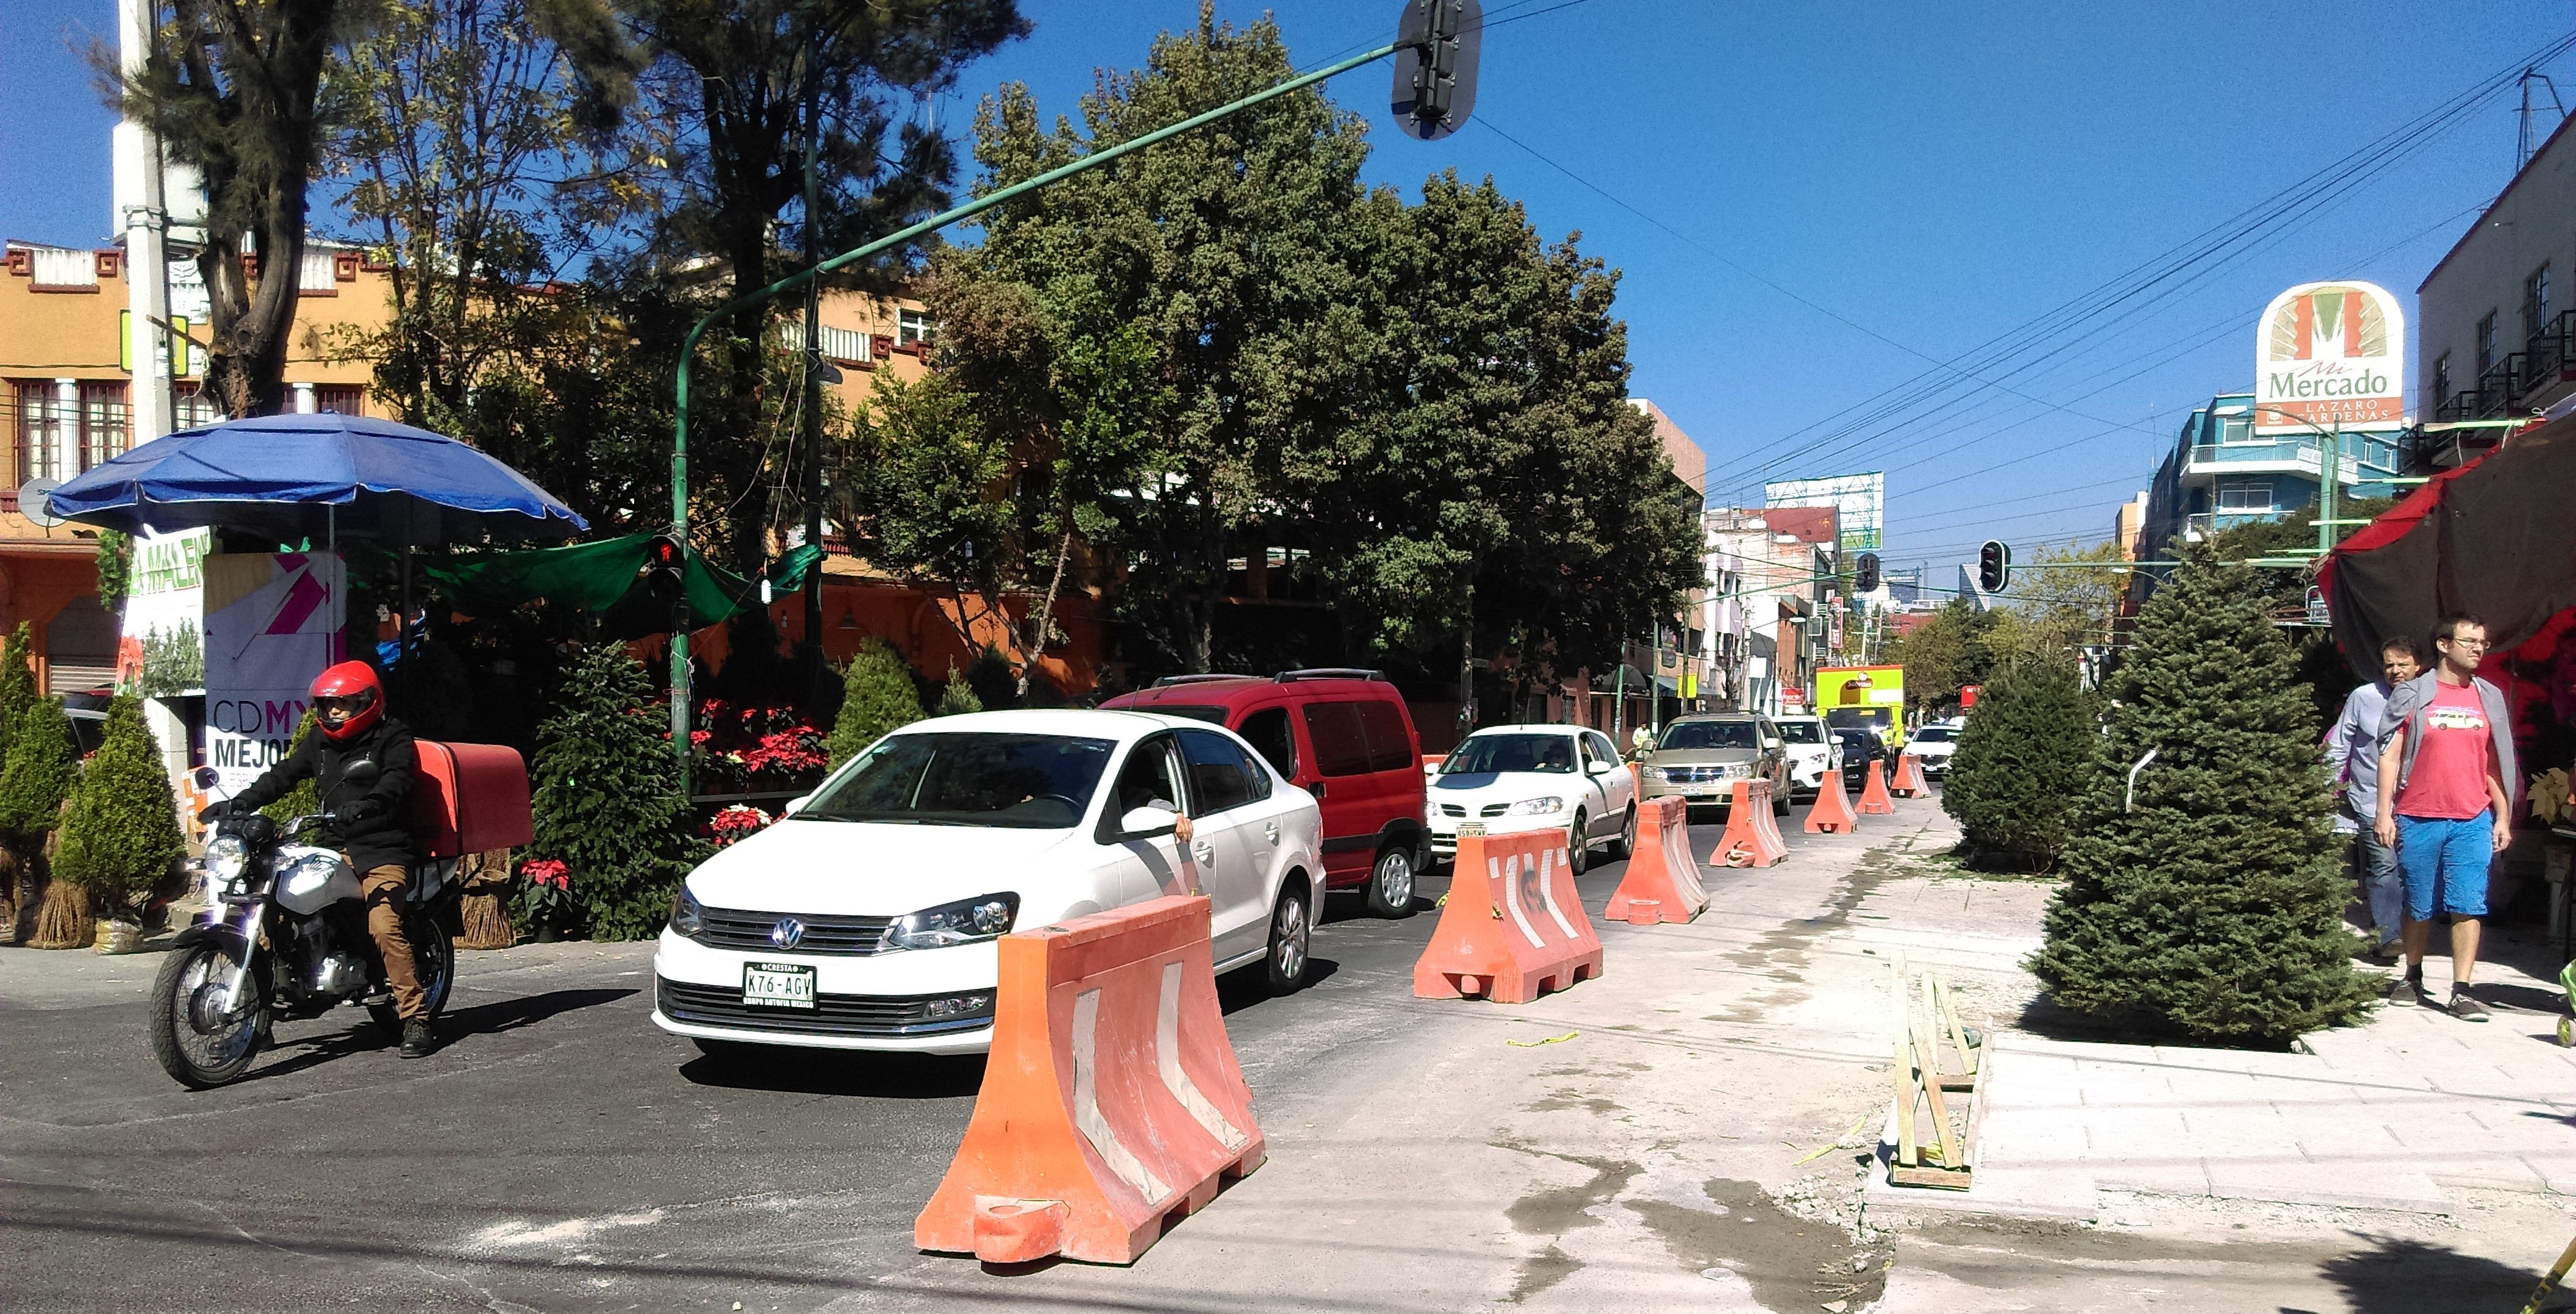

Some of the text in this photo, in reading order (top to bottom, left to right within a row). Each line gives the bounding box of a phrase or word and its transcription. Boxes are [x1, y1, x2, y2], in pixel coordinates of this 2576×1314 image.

[2297, 360, 2352, 377] Mi
[2269, 368, 2388, 398] Mercado
[2306, 400, 2378, 413] LAZARO
[2295, 409, 2389, 423] CARDENAS
[767, 963, 792, 972] CRESTA
[748, 975, 810, 996] K76-AGV
